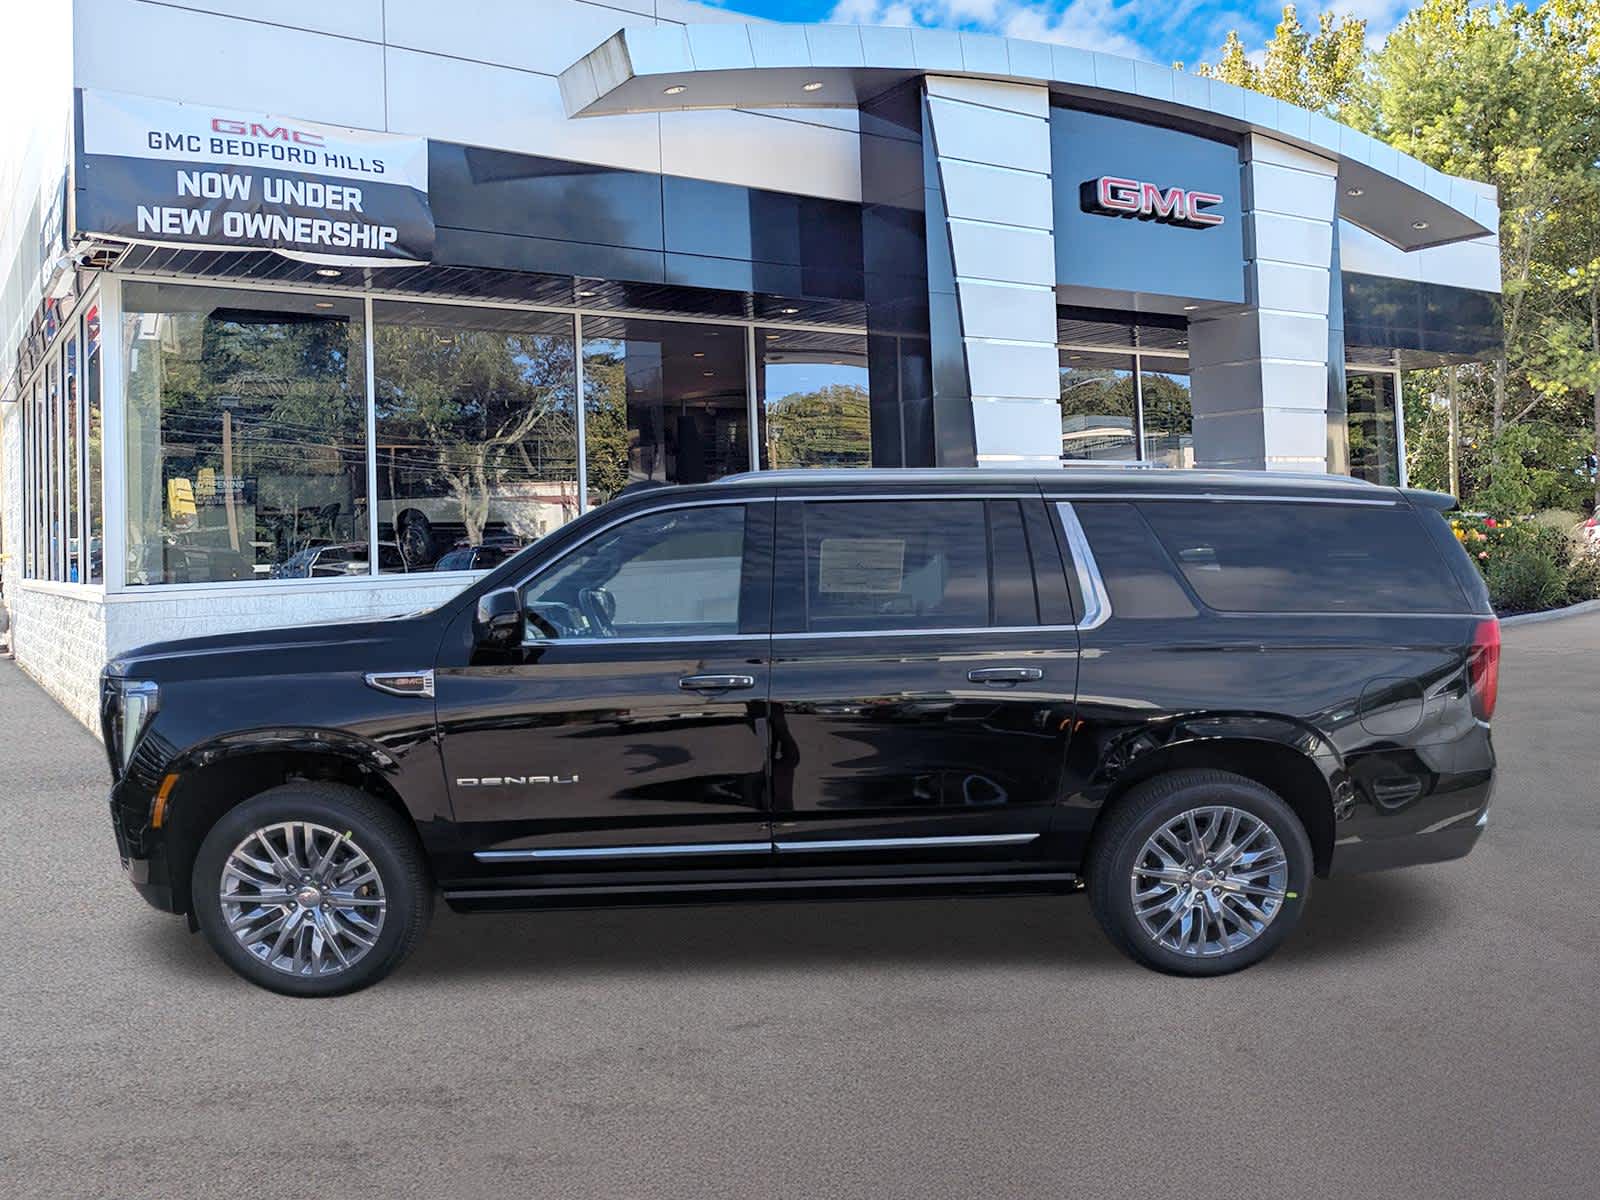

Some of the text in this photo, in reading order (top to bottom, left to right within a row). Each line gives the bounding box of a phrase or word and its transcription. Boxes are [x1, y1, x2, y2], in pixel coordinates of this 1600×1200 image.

[148, 131, 385, 174] GMC BEDFORD HILLS
[211, 118, 325, 147] GMC
[176, 170, 363, 213] NOW UNDER
[1098, 175, 1225, 225] GMC
[136, 205, 398, 250] NEW OWNERSHIP
[456, 774, 579, 786] DENALI
